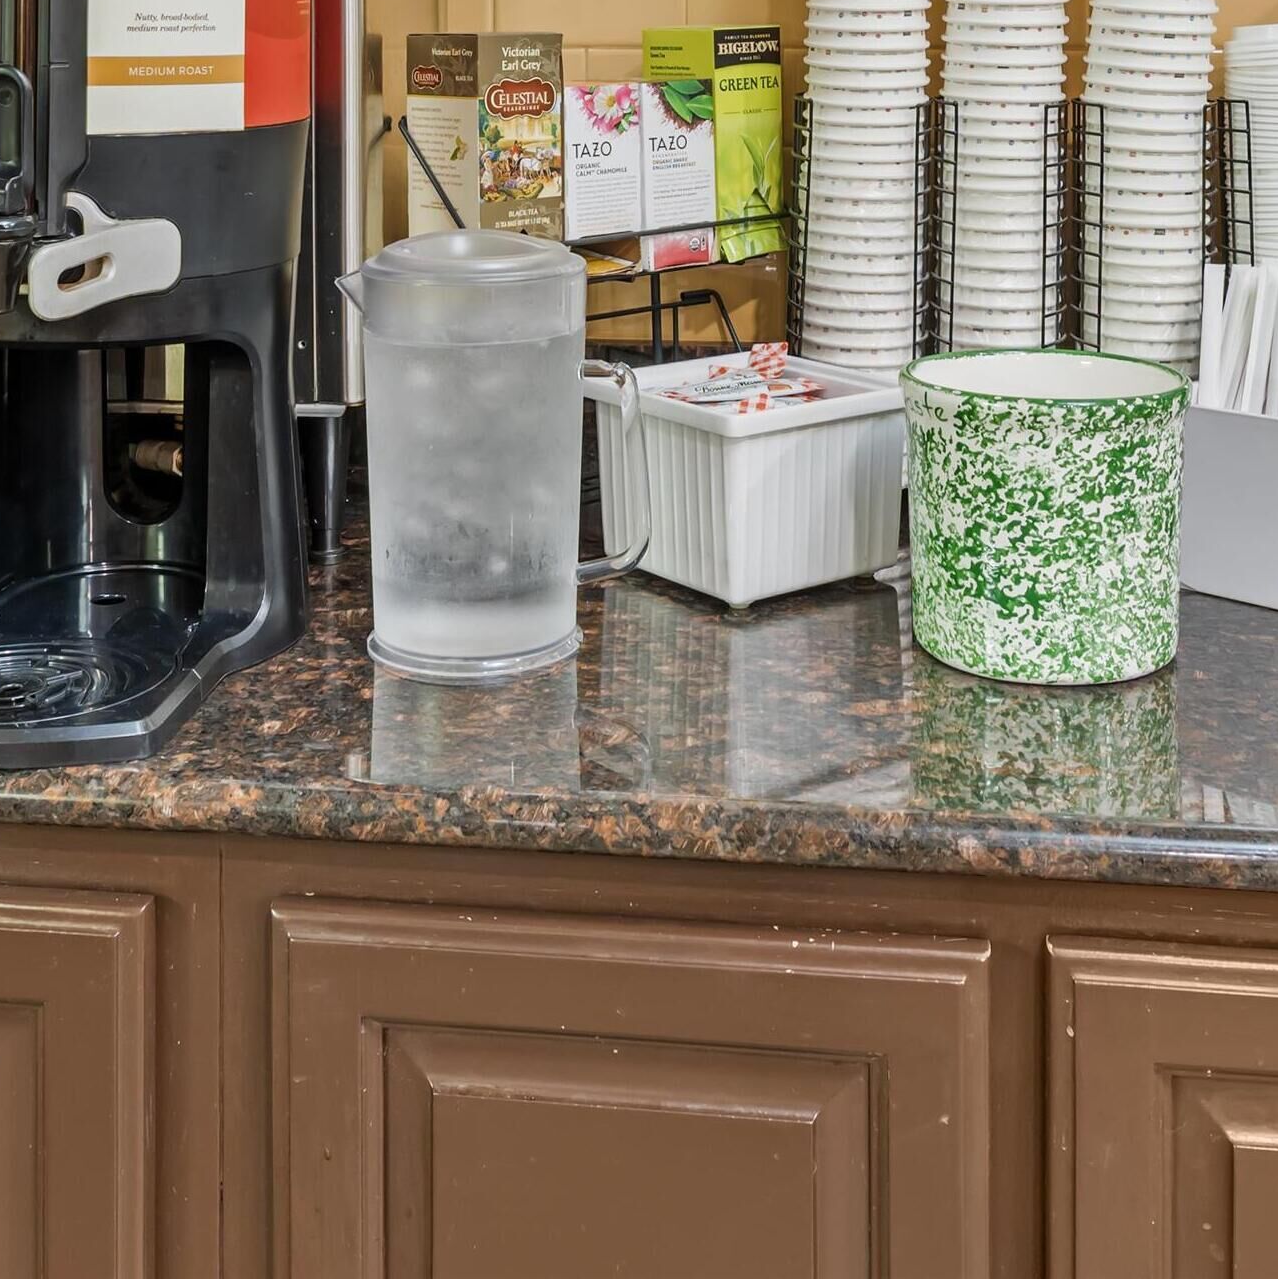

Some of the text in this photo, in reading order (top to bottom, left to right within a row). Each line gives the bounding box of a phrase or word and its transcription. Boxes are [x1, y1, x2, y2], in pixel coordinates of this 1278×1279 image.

[126, 23, 216, 34] medium roast perfection
[502, 46, 541, 58] Victorian
[717, 40, 779, 55] BIGELOW
[128, 65, 215, 77] MEDIUM ROAST
[502, 60, 541, 72] Earl Grey
[719, 75, 779, 91] GREEN TEA
[490, 89, 551, 108] CELESTIAL
[649, 135, 688, 152] TAZO
[572, 141, 612, 159] TAZO
[576, 162, 601, 170] ORGANIC
[596, 167, 627, 176] CHAMOMILE
